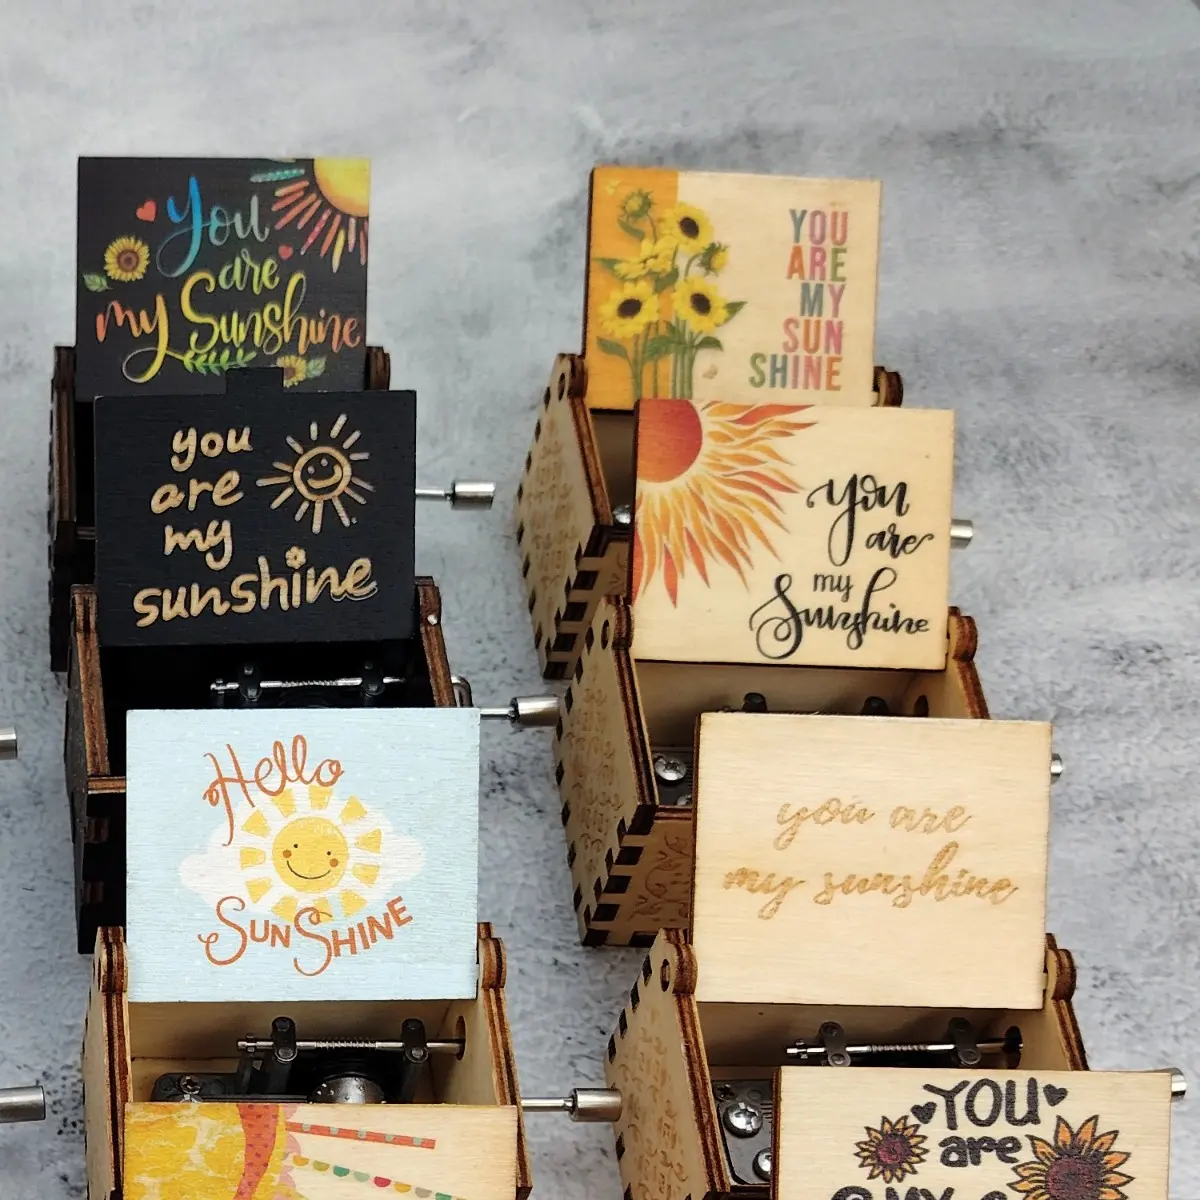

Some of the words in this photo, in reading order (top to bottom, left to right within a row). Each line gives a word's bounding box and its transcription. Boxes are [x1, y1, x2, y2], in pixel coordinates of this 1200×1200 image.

[156, 176, 270, 278] You
[788, 208, 848, 246] YOU
[218, 248, 280, 295] are
[786, 245, 847, 282] ARE
[800, 282, 846, 318] MY
[96, 293, 168, 383] my
[181, 271, 361, 355] Sunshine
[782, 318, 843, 355] SUN
[750, 352, 843, 391] SHINE
[170, 426, 252, 472] you
[151, 470, 244, 514] are
[164, 520, 233, 570] my
[865, 523, 934, 558] are
[133, 546, 377, 627] sunshine
[813, 573, 854, 602] my
[749, 567, 930, 660] Sunshine
[203, 735, 344, 846] Hello
[774, 798, 875, 850] you
[889, 805, 971, 835] are
[724, 867, 805, 921] my
[813, 841, 1019, 909] sunshine
[923, 1077, 1041, 1130] YOU
[939, 1135, 1022, 1167] are
